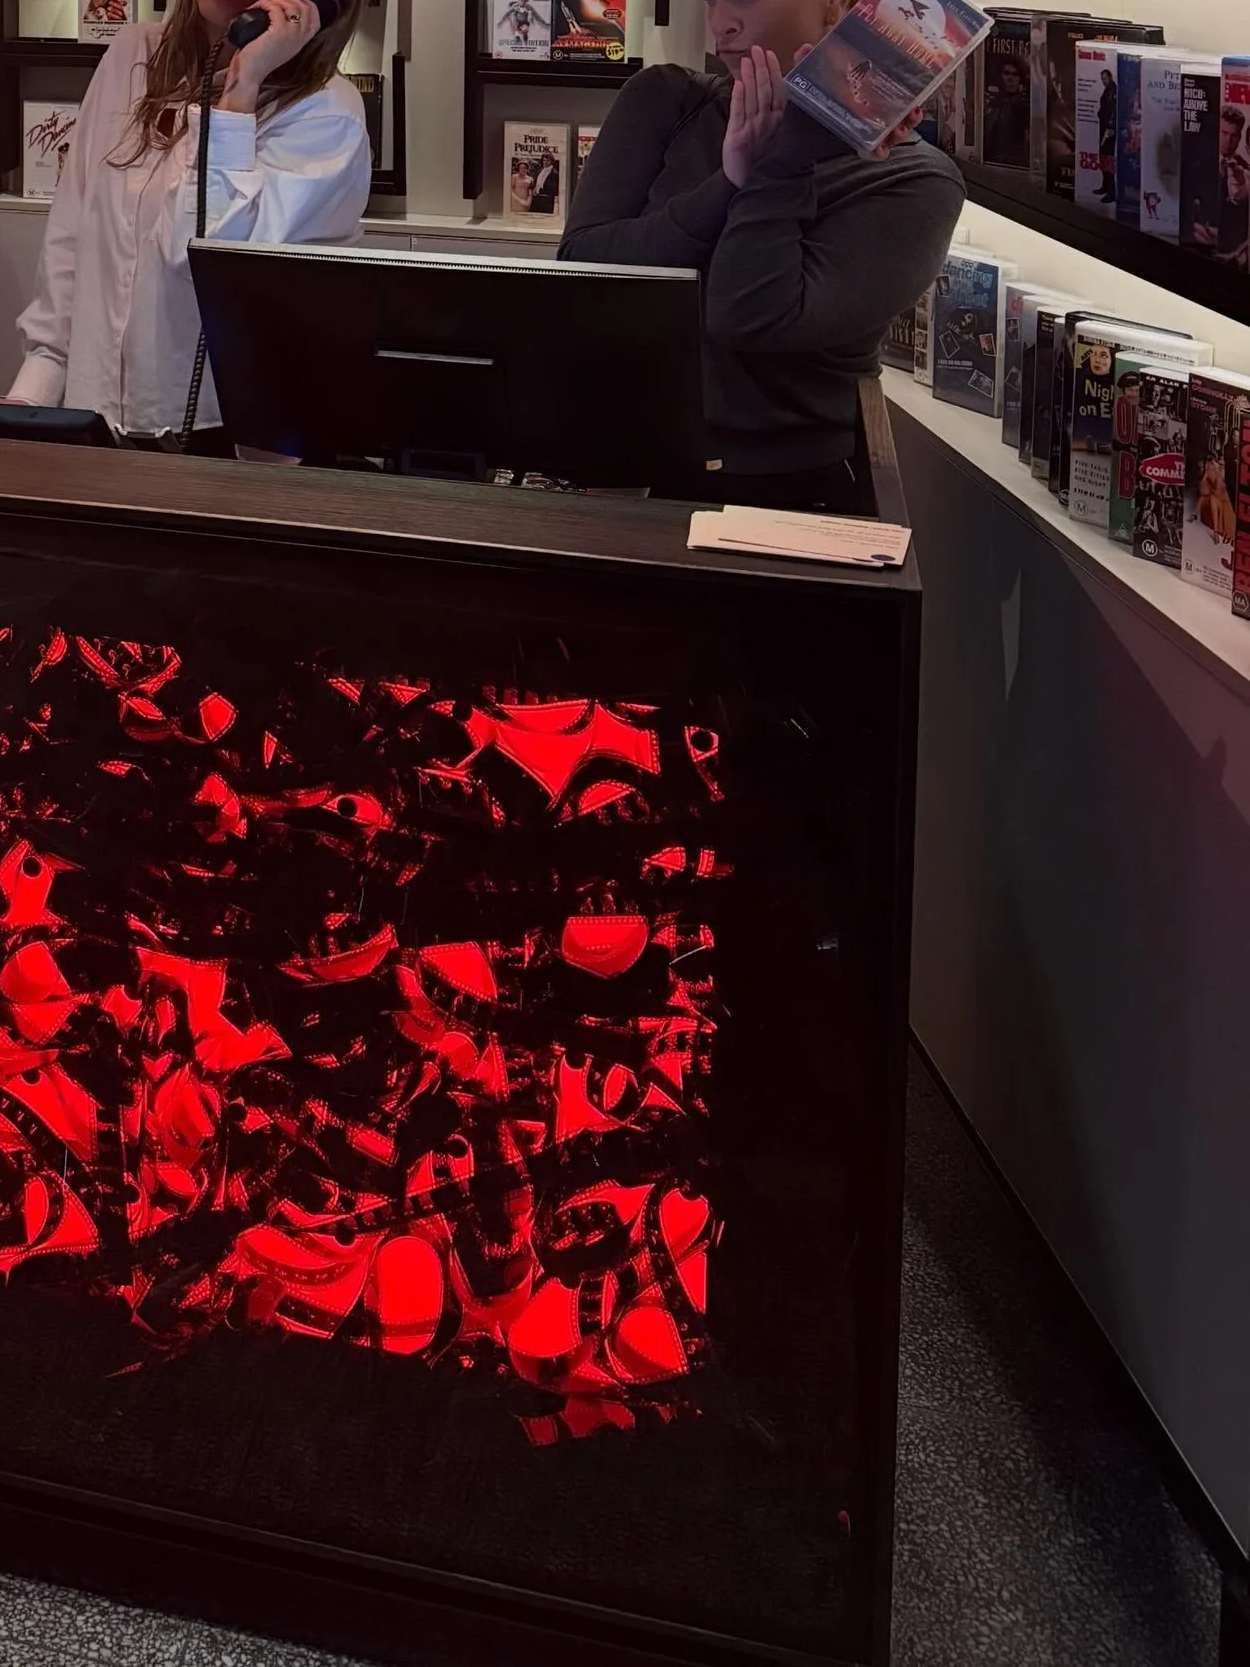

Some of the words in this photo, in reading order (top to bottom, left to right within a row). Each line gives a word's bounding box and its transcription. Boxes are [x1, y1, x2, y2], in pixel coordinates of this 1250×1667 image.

[992, 39, 1016, 55] FIRST
[906, 40, 936, 69] HOME
[1183, 110, 1197, 122] THE
[1184, 121, 1201, 133] LAW
[523, 134, 549, 144] PRIDE
[514, 142, 559, 154] PREJUDICE
[1084, 378, 1113, 405] Nig
[1079, 403, 1097, 417] on
